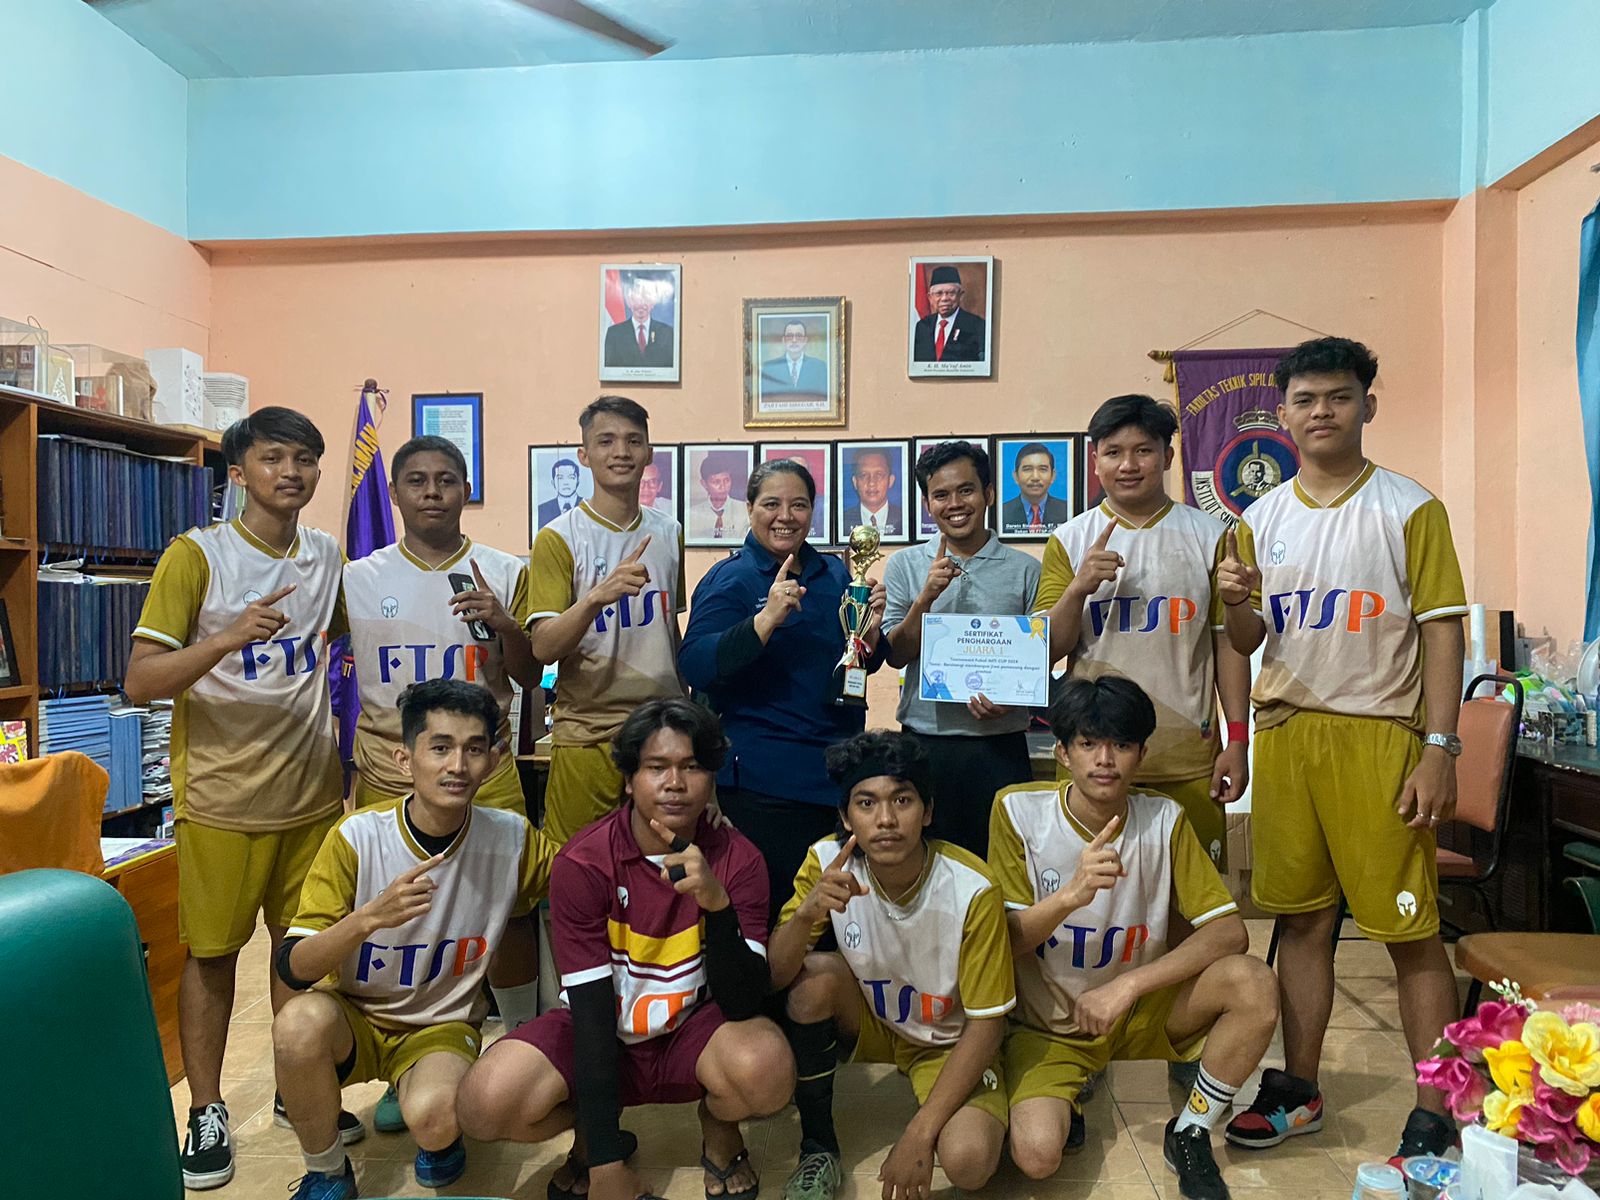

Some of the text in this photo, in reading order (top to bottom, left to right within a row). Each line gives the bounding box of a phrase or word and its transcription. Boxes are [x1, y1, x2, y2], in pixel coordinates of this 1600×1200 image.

[1186, 385, 1220, 417] FAKULTAS
[1217, 374, 1247, 394] TEKNIK
[1248, 372, 1267, 387] SIPIL
[1195, 477, 1240, 532] INSTITUT SAINS
[1089, 595, 1198, 636] FTSP
[1268, 587, 1387, 634] FTSP
[241, 629, 328, 681] FTS
[378, 643, 489, 684] FTSP
[956, 637, 1012, 645] PENGHARGAAN
[963, 645, 996, 655] JUARA
[355, 934, 489, 987] FTSP
[862, 978, 954, 1026] TSP
